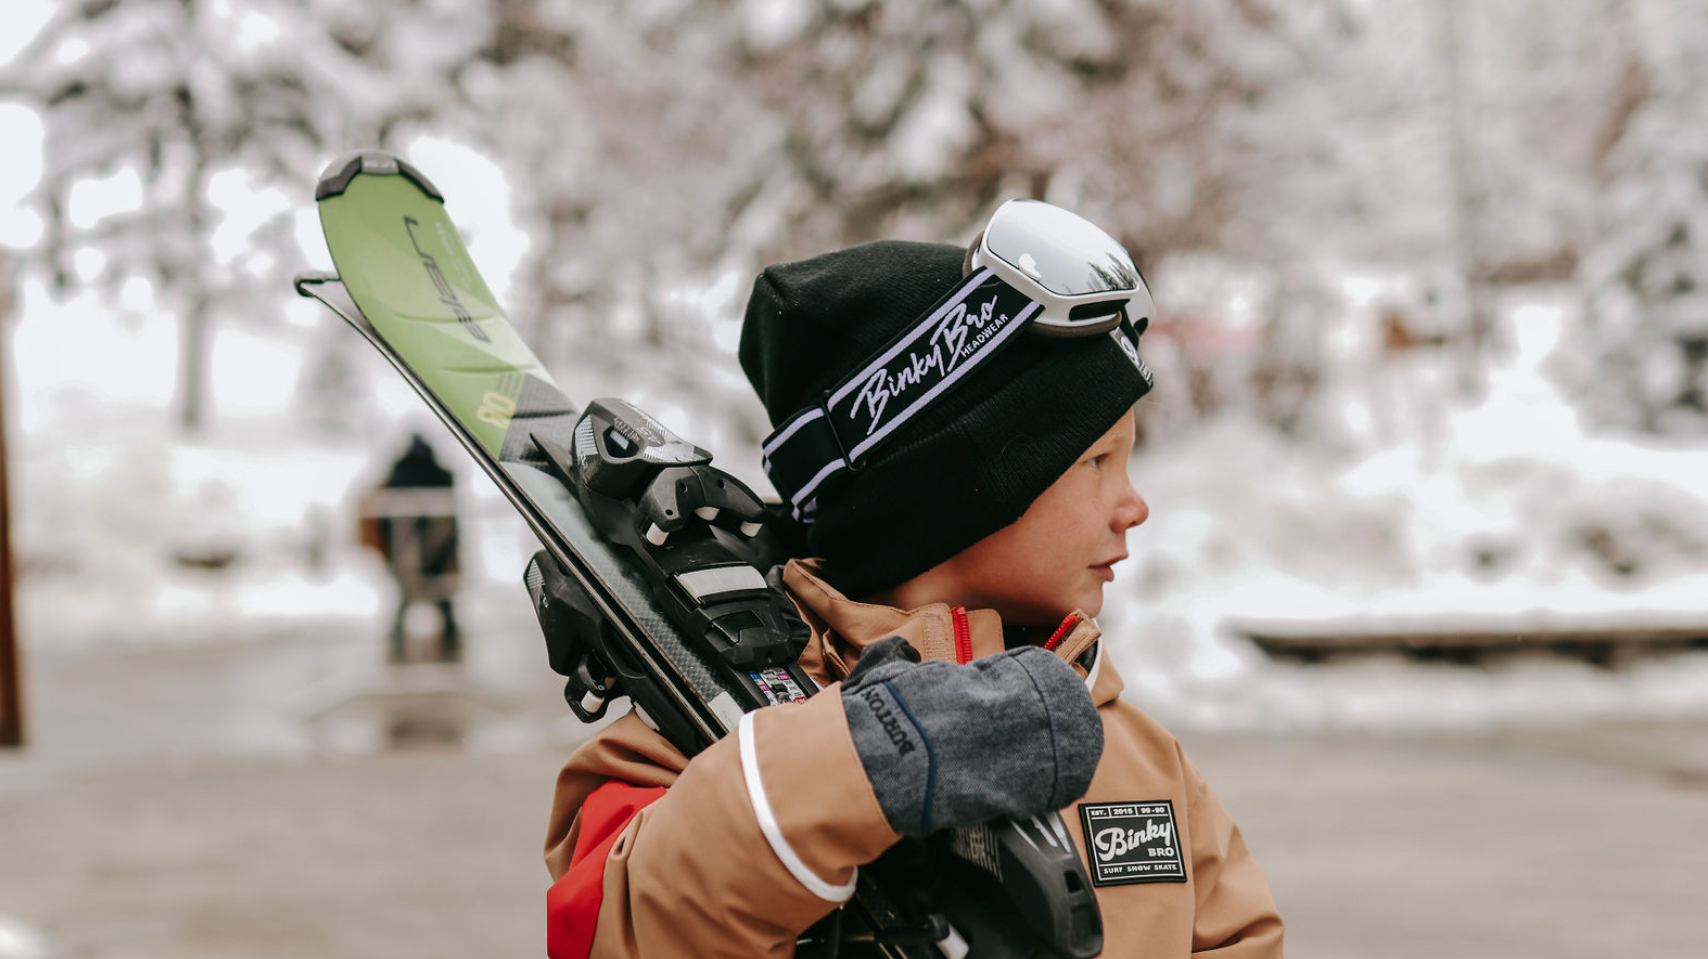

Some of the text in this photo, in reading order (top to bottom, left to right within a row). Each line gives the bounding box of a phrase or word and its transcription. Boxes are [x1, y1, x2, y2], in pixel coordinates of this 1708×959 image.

[960, 313, 1009, 358] HEADWEAR
[861, 687, 916, 756] BURTON
[1094, 819, 1171, 861] Binky
[1147, 847, 1175, 857] BRO
[1103, 866, 1123, 874] SURF
